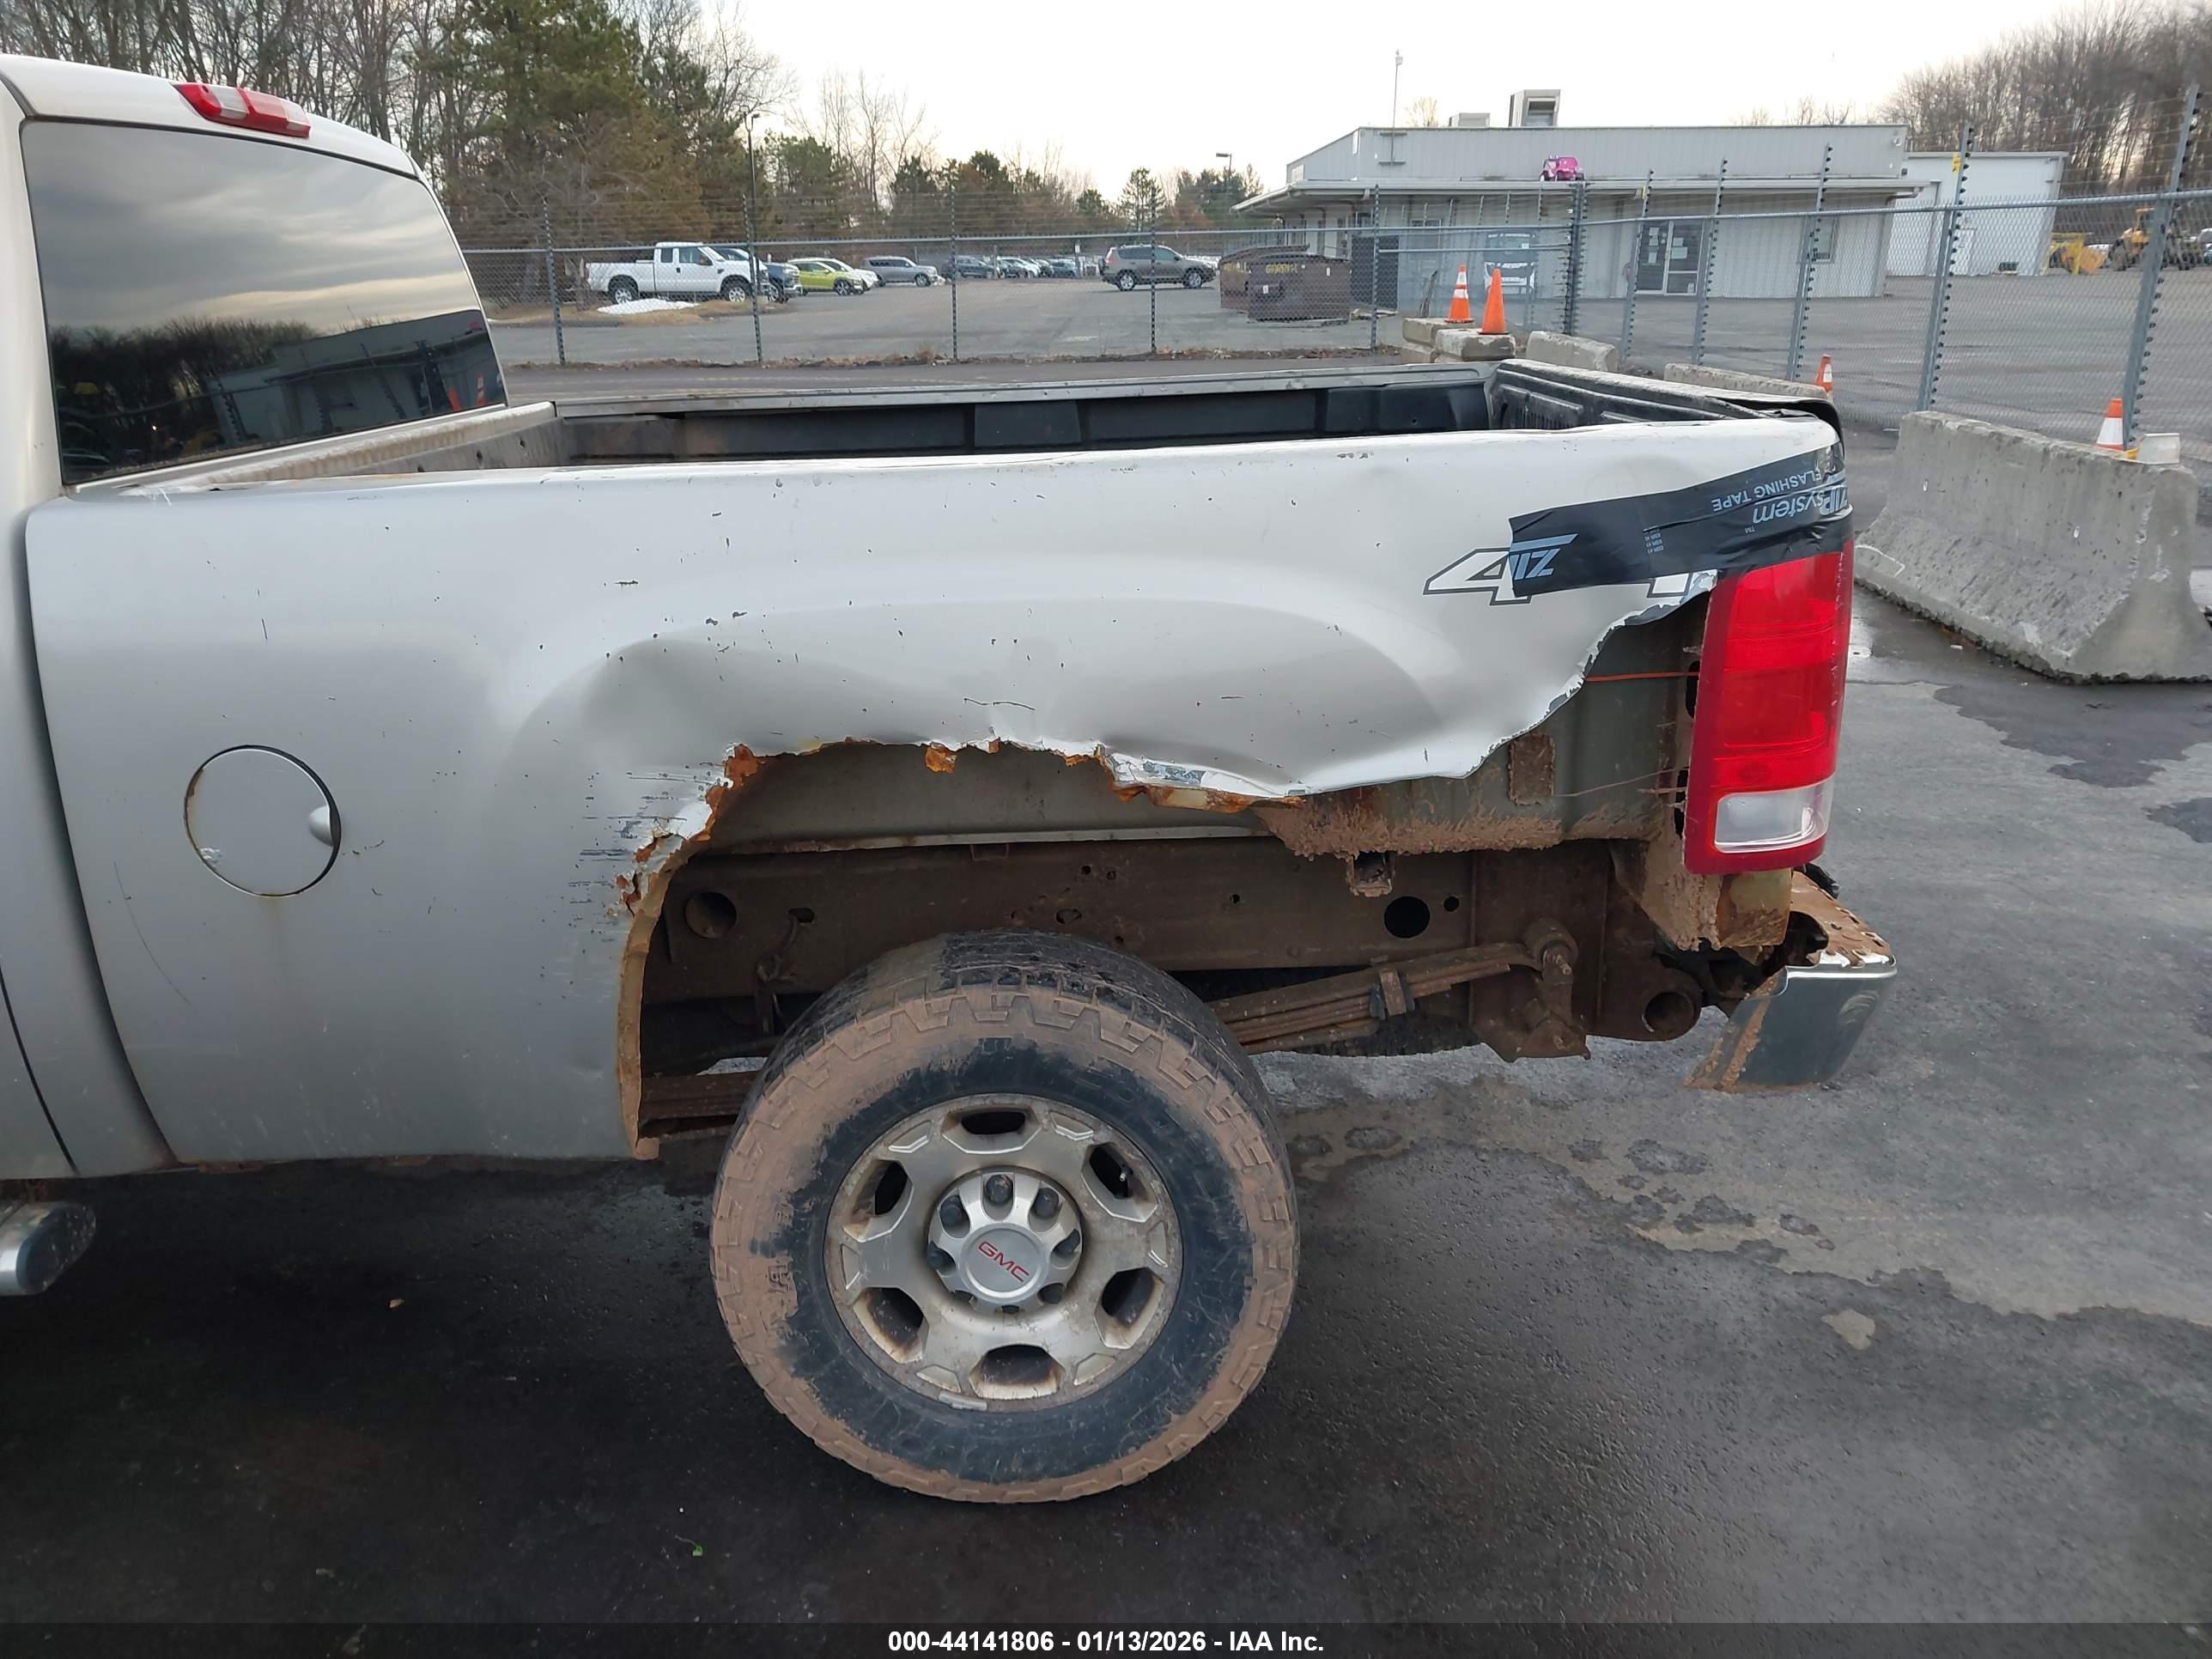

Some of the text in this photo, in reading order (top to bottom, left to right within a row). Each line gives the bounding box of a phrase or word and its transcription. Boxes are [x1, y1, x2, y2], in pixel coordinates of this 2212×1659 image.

[1711, 470, 1822, 512] FLASHING TAPE
[977, 1240, 1030, 1283] GMC
